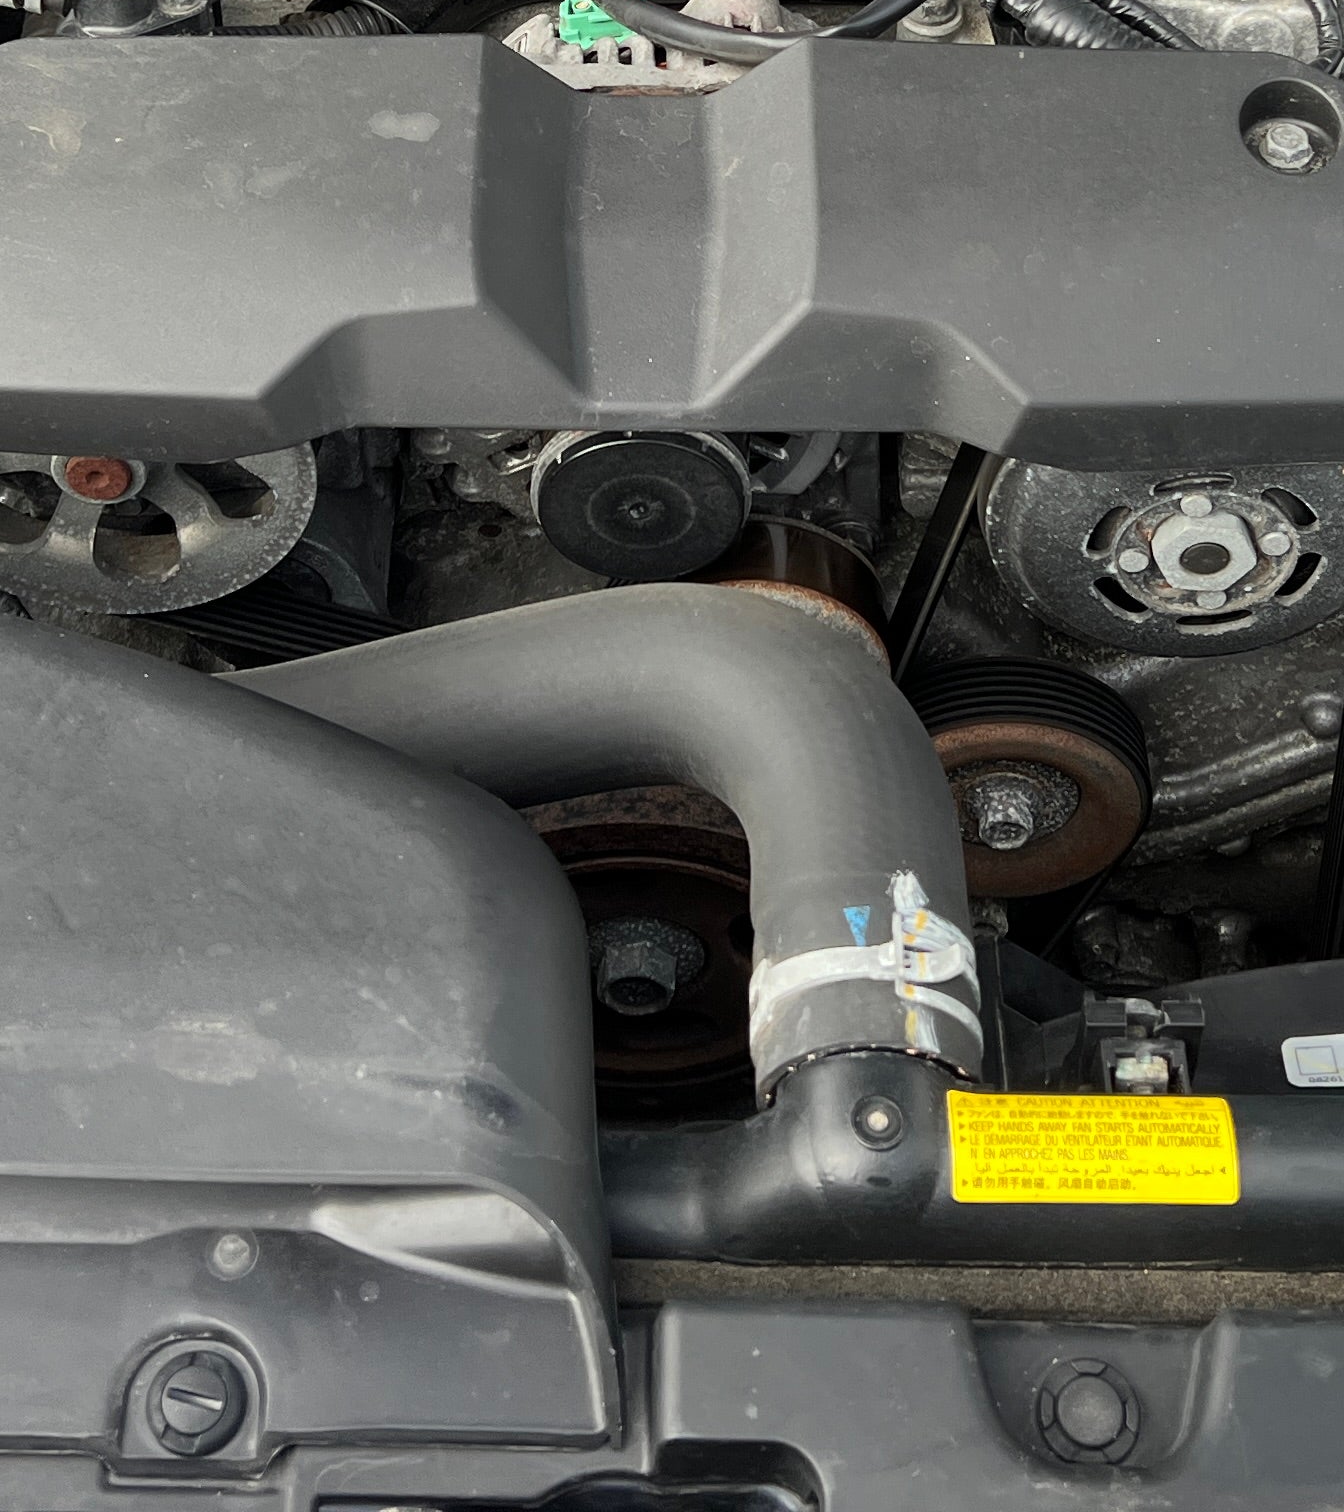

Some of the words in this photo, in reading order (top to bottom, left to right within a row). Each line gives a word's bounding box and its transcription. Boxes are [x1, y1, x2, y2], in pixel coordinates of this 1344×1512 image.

[1016, 1097, 1073, 1107] CAUTION
[1080, 1097, 1160, 1108] ATTENTION
[968, 1120, 994, 1132] KEEP
[998, 1121, 1034, 1133] HANDS
[1038, 1121, 1067, 1133] AWAY
[1072, 1121, 1092, 1133] FAN
[1096, 1121, 1135, 1134] STARTS
[1138, 1122, 1221, 1135] AUTOMATICALLY
[969, 1134, 980, 1146] LE
[1045, 1134, 1059, 1146] DU
[1062, 1134, 1122, 1147] VENTILATEUR
[983, 1148, 996, 1160] EN
[999, 1148, 1053, 1161] APPROCHEZ
[1057, 1148, 1075, 1161] PAS
[1078, 1148, 1095, 1161] LES
